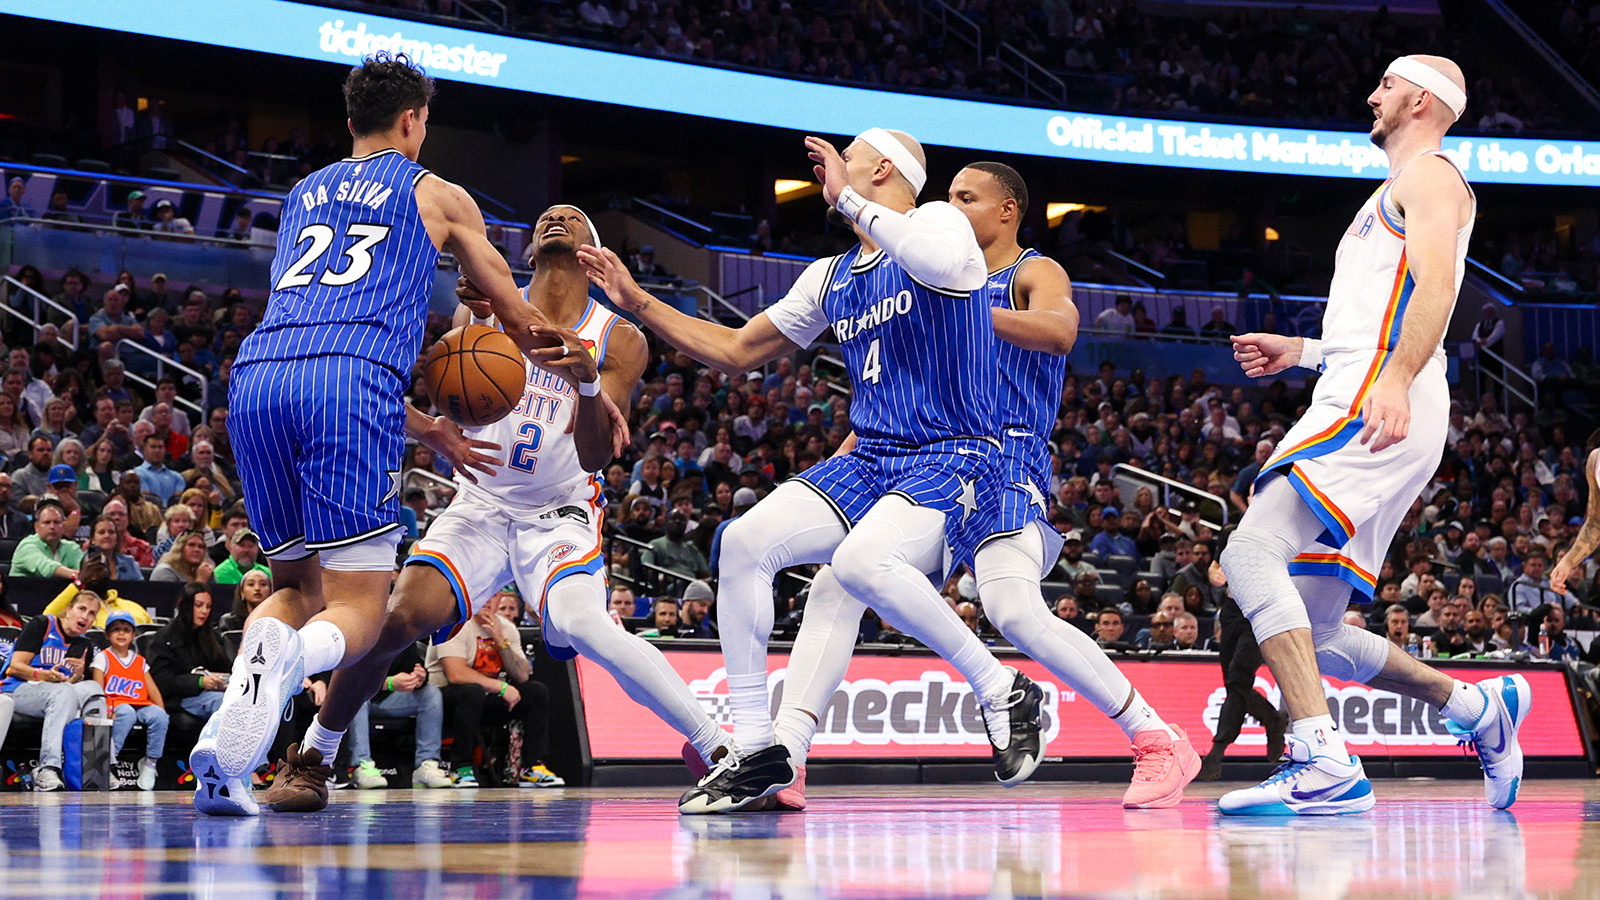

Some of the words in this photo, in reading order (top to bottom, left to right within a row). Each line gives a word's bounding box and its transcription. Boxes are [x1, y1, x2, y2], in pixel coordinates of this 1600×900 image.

[318, 19, 507, 78] ticketmaster
[1047, 115, 1154, 154] Official
[1157, 125, 1248, 160] Ticket
[1477, 142, 1528, 173] the
[302, 184, 329, 212] DA
[336, 179, 393, 210] SILVA
[272, 223, 392, 293] 23
[862, 338, 882, 385] 4
[508, 421, 545, 475] 2
[105, 675, 144, 698] OKC
